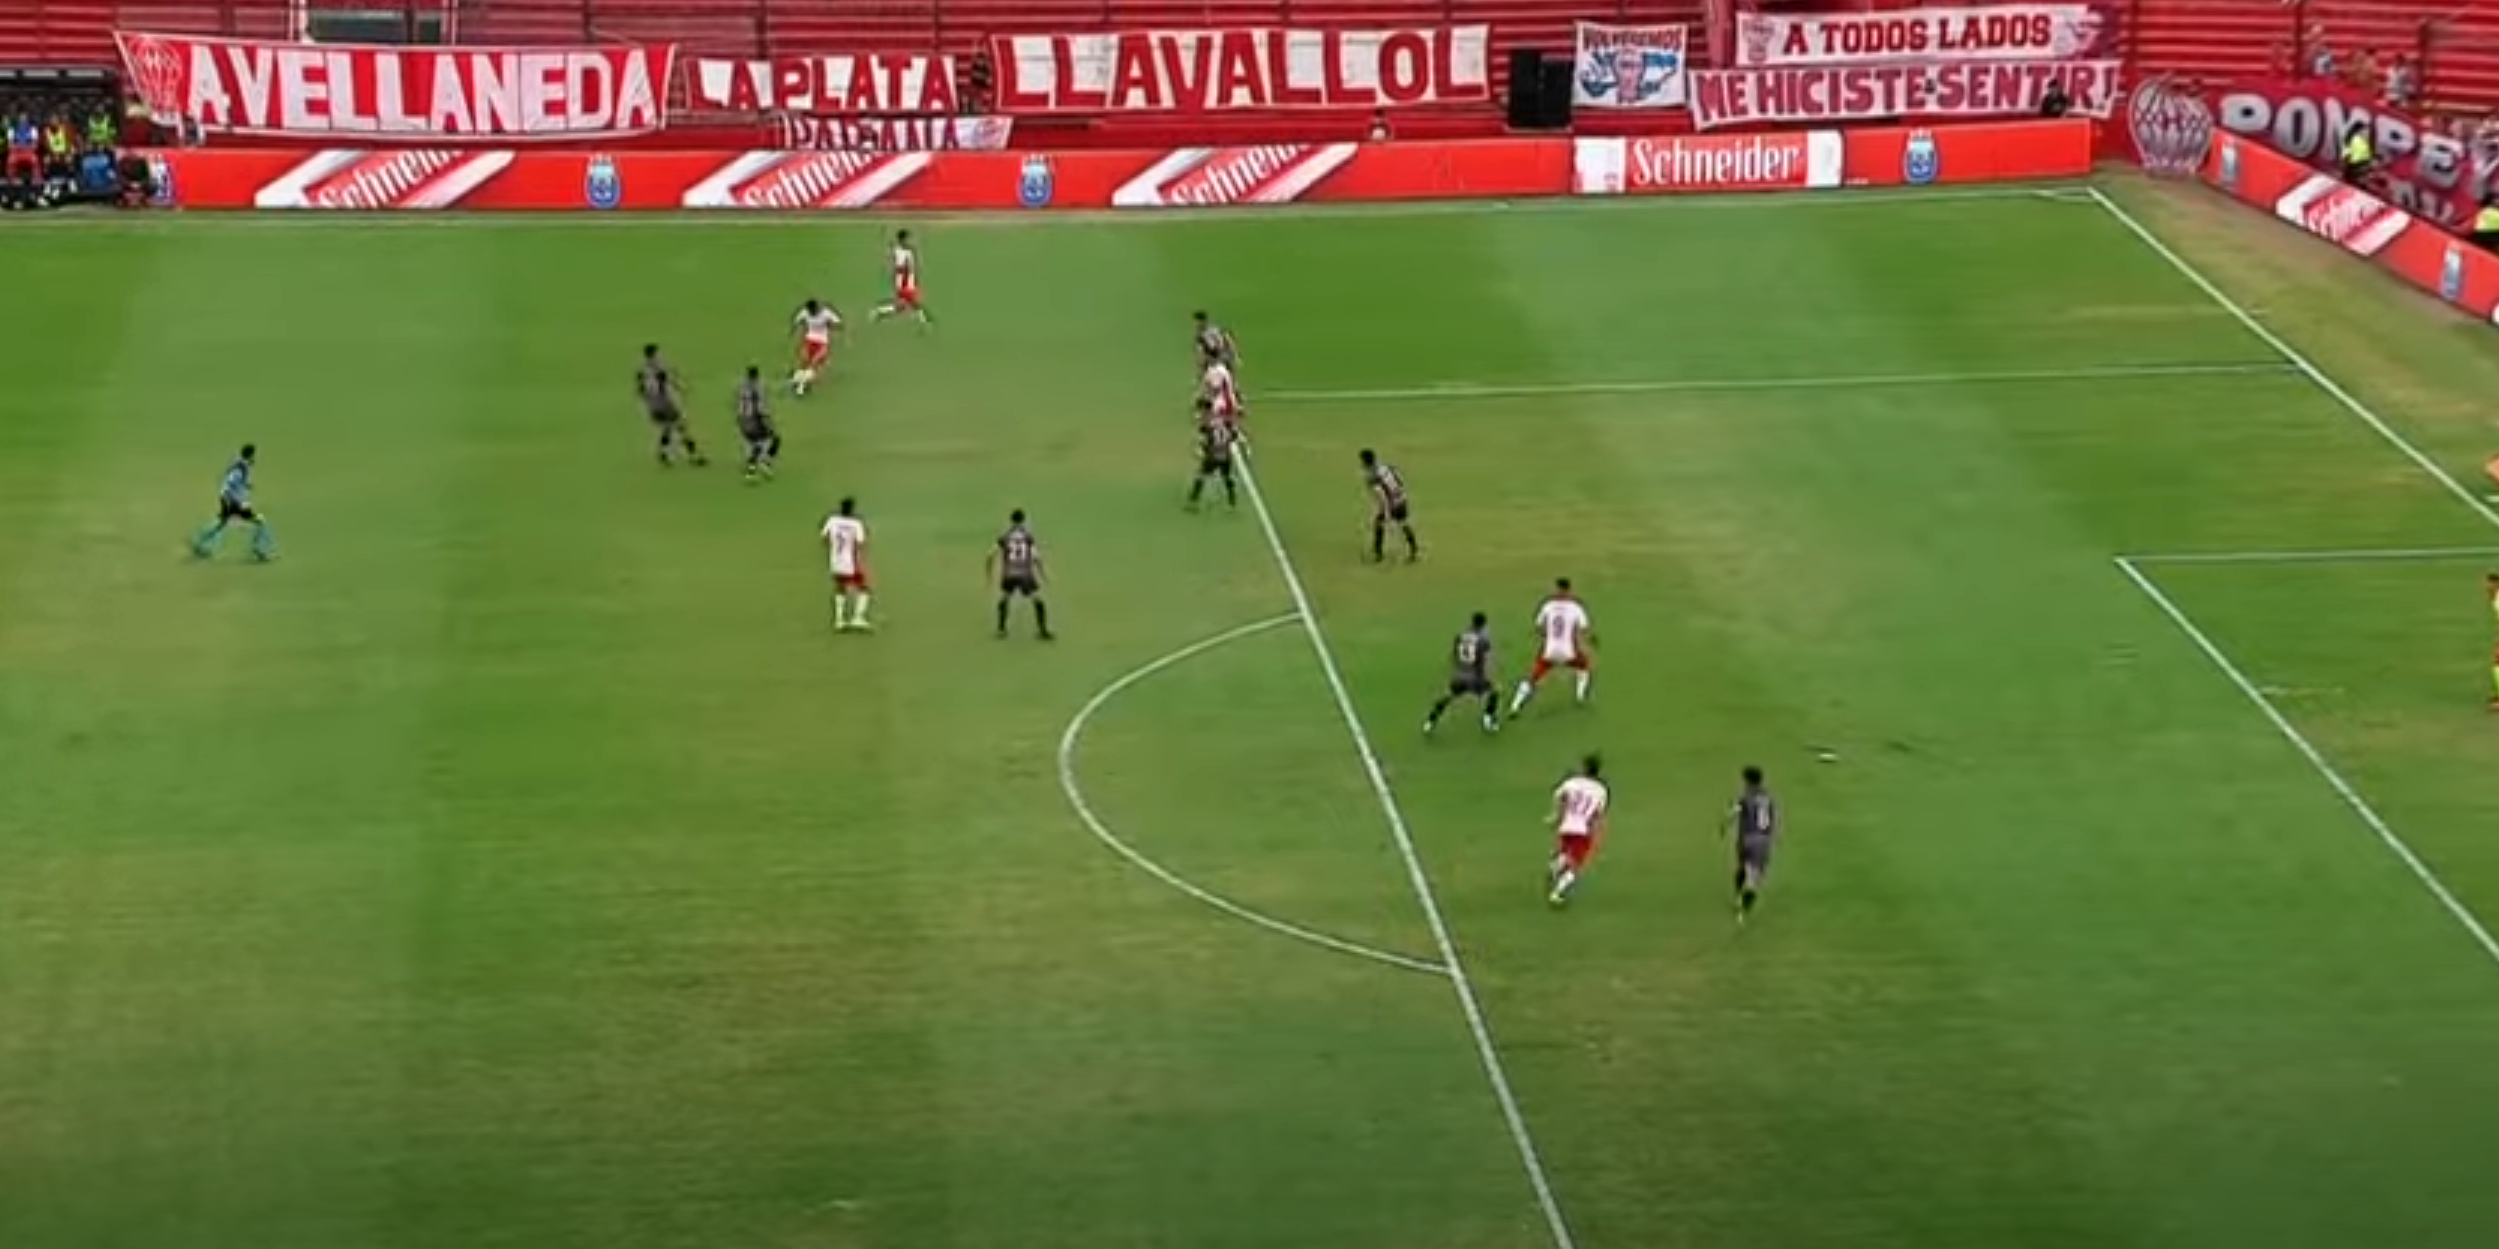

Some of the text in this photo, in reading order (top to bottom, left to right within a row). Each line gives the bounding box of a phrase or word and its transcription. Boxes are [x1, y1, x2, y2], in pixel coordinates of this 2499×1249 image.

[1783, 14, 2051, 54] A TODOS LADOS
[186, 43, 658, 132] AVELLANEDA
[688, 55, 957, 112] LA PLATA
[996, 27, 1486, 108] LLAVALLOL
[1696, 72, 1749, 122] ME
[1756, 65, 1926, 116] HICISTE
[1632, 136, 1800, 186] Schneider
